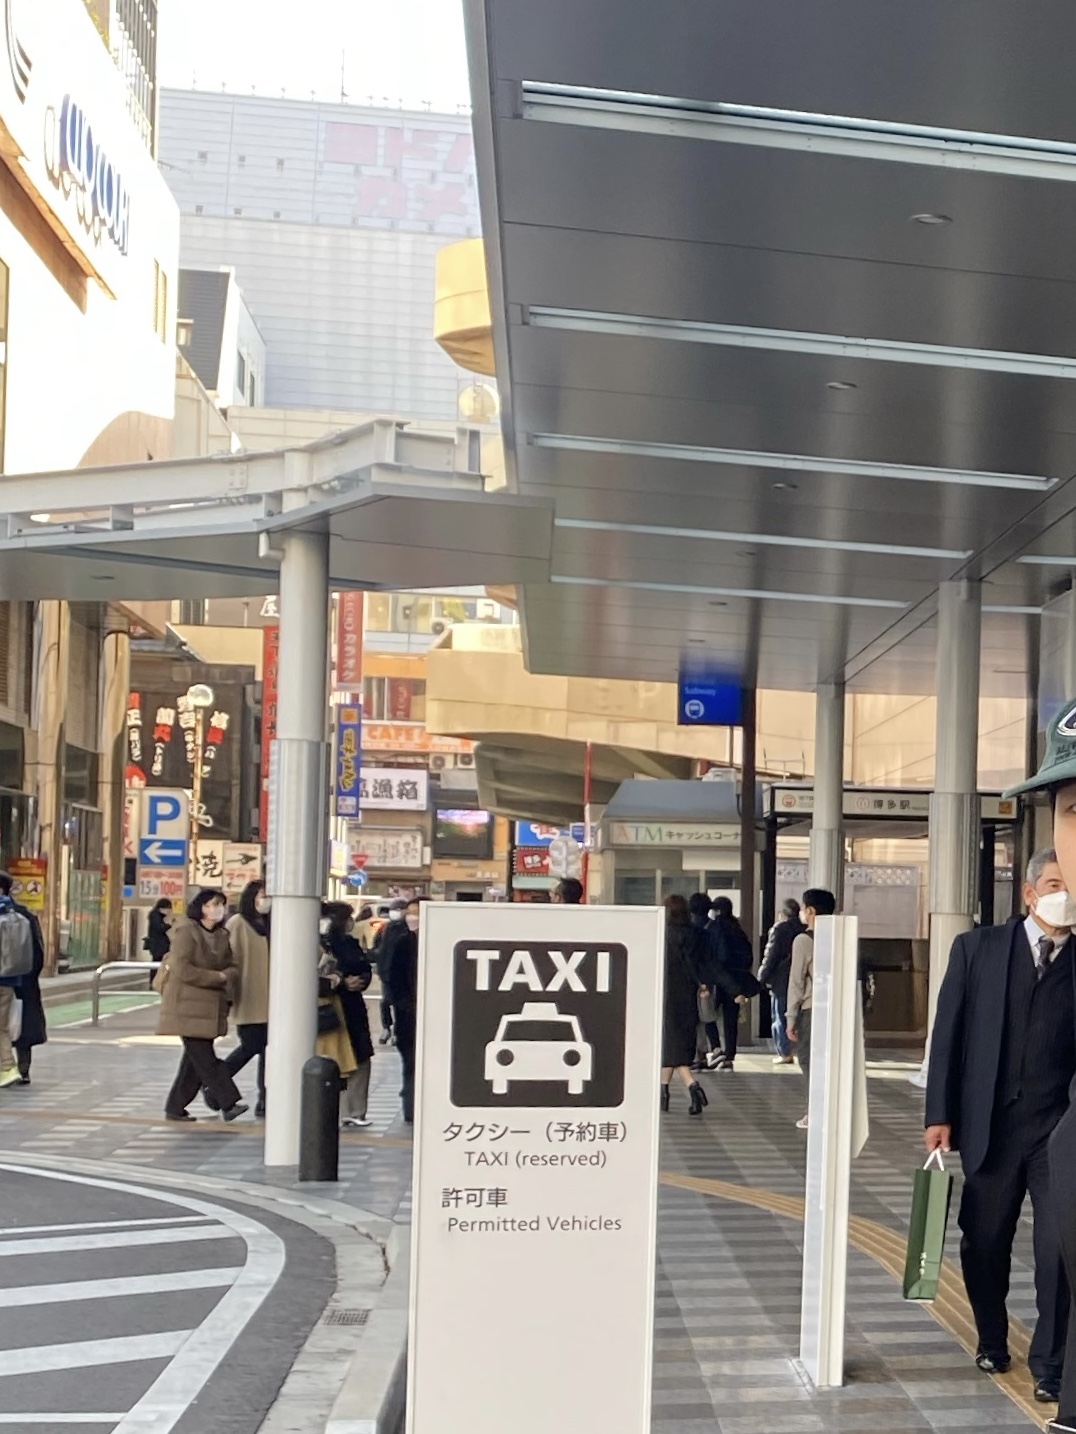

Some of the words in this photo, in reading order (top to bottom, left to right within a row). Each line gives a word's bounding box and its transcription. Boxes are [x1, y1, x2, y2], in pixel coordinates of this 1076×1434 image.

[684, 686, 717, 697] Subway
[147, 794, 181, 836] P
[617, 826, 664, 843] ATM
[466, 949, 611, 993] TAXI
[464, 1151, 509, 1167] TAXI
[515, 1150, 608, 1169] (reserved)
[441, 1187, 508, 1209] 許可車
[447, 1217, 540, 1233] Permitted
[547, 1215, 623, 1232] Vehicles
